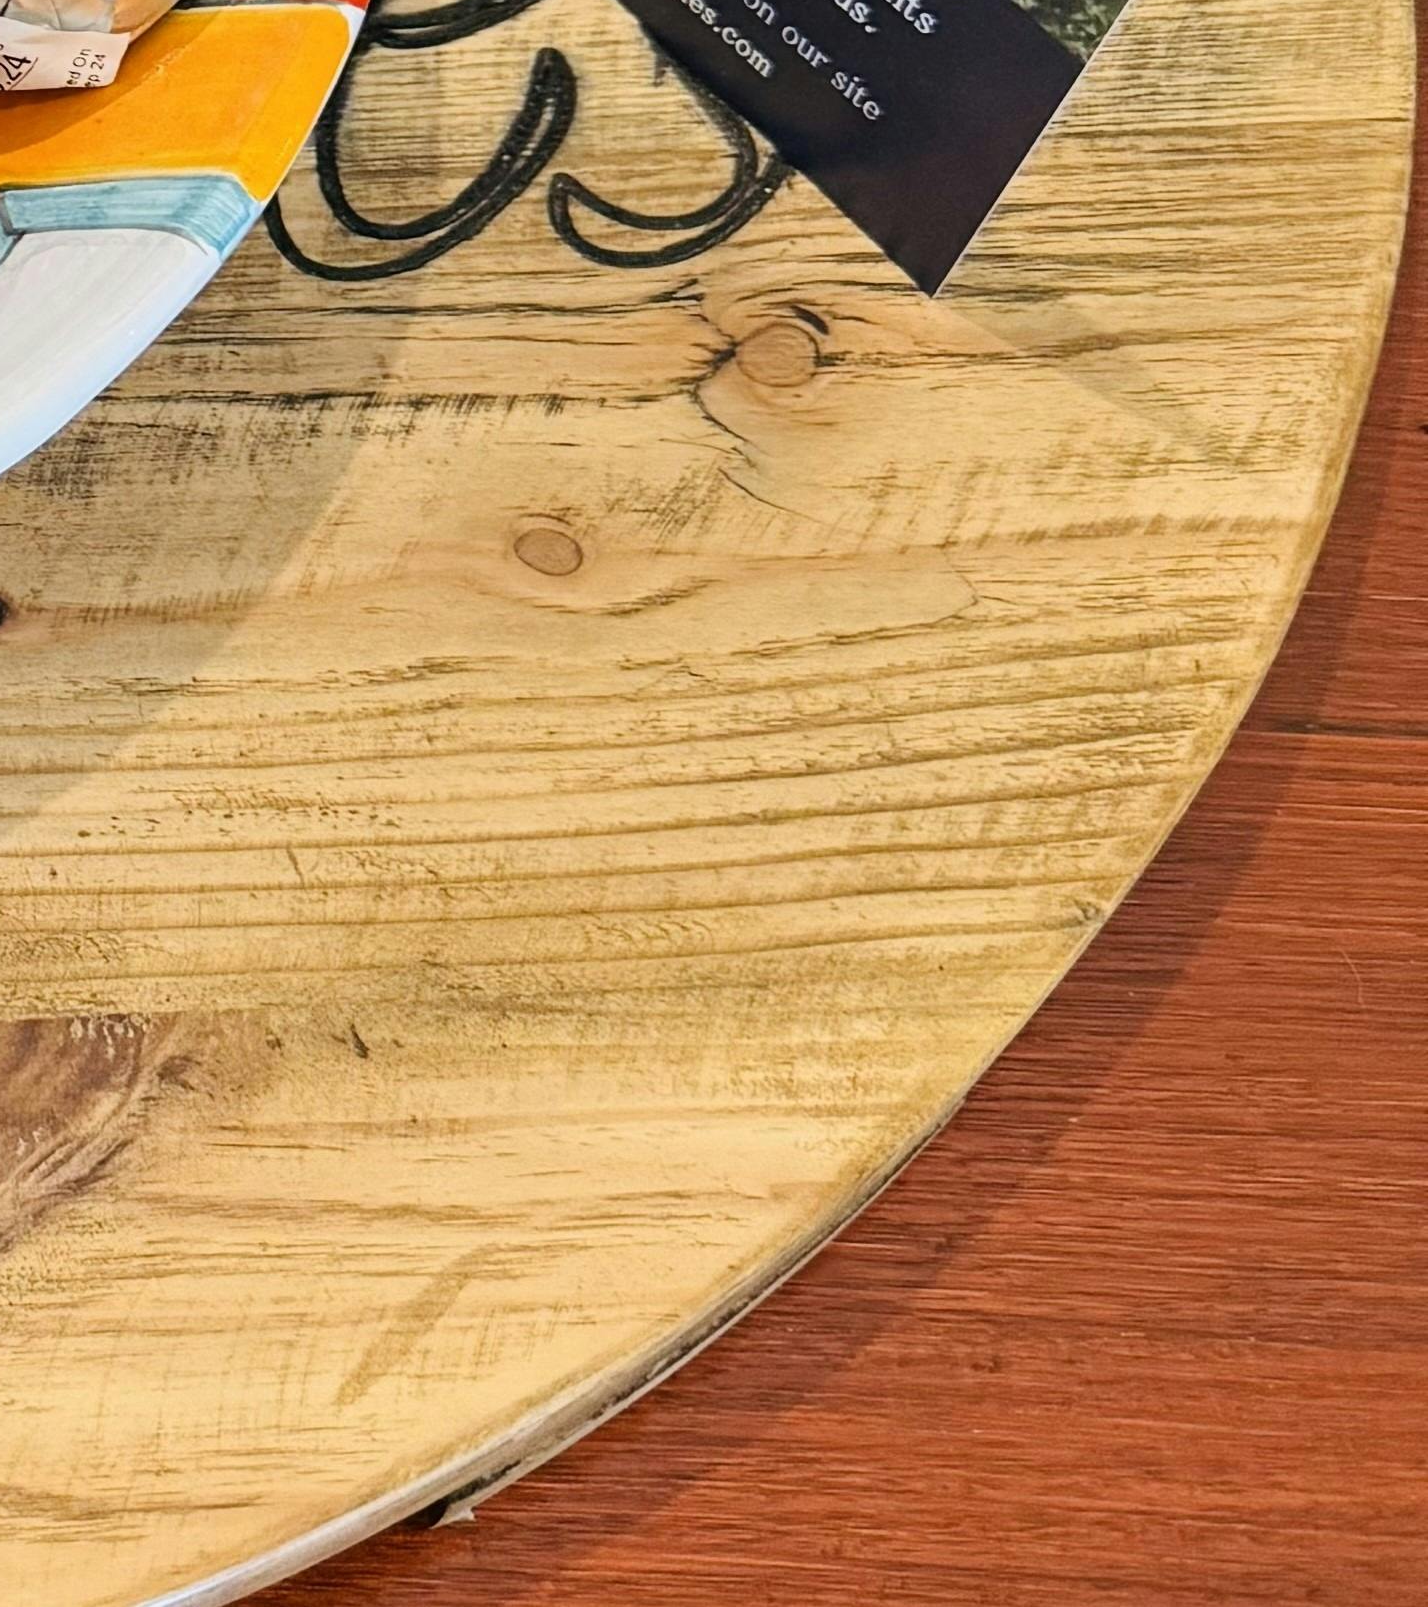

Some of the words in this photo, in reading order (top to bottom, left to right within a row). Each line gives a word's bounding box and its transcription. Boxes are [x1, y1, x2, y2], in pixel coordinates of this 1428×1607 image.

[72, 48, 93, 68] On
[780, 26, 833, 69] our
[830, 69, 886, 122] site
